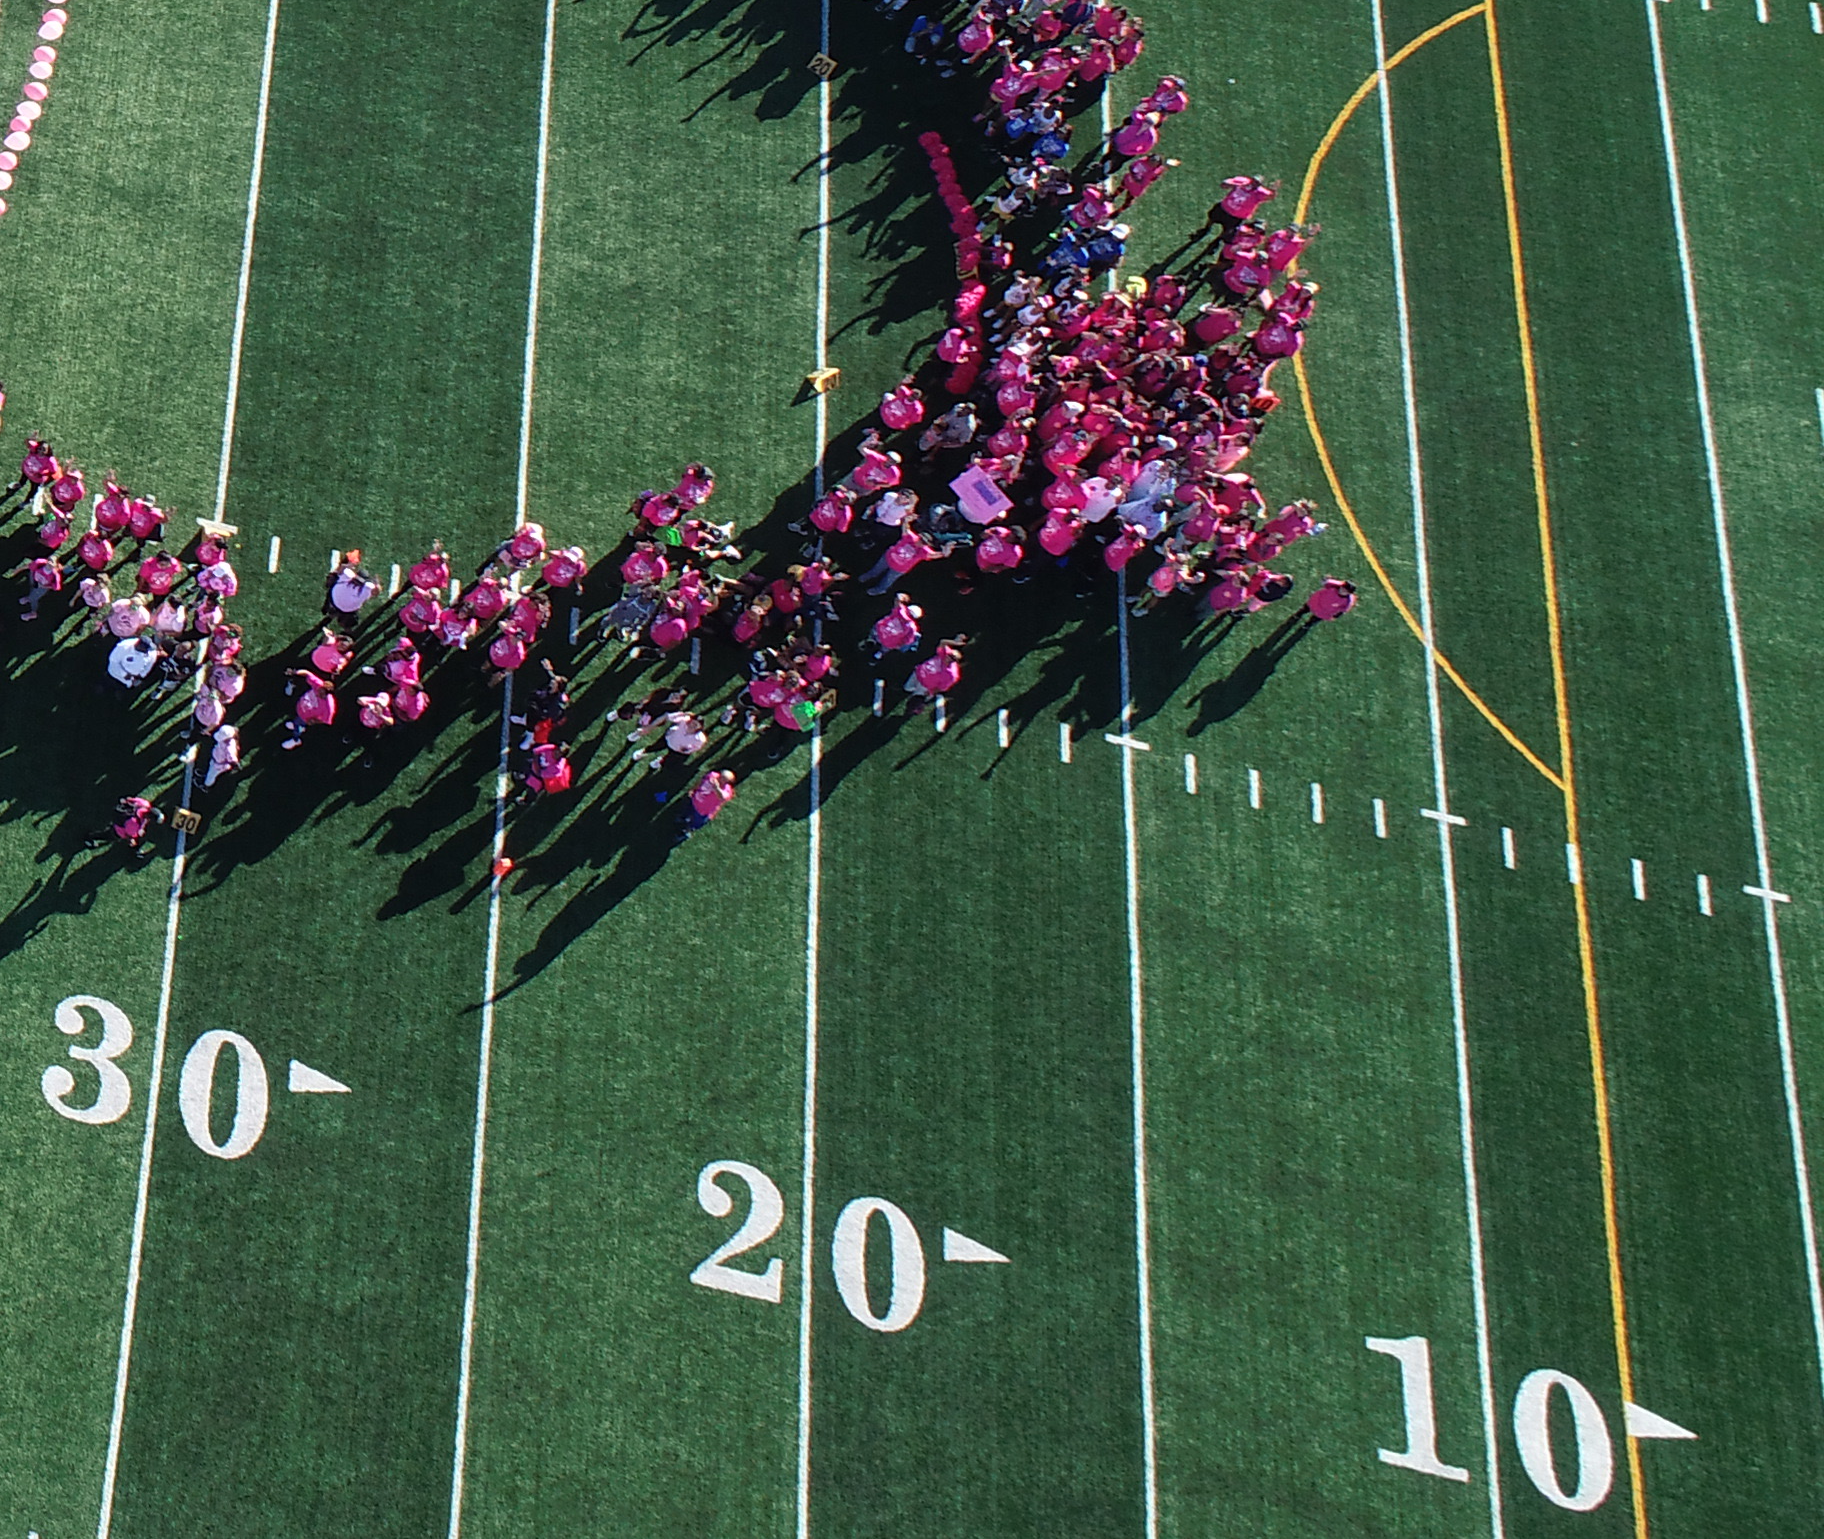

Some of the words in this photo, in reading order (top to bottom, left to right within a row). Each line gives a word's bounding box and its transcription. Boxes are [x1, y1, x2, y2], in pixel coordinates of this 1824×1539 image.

[811, 57, 831, 75] 20
[176, 814, 197, 832] 30
[41, 995, 268, 1159] 30
[691, 1161, 924, 1331] 20
[1366, 1337, 1612, 1511] 10
